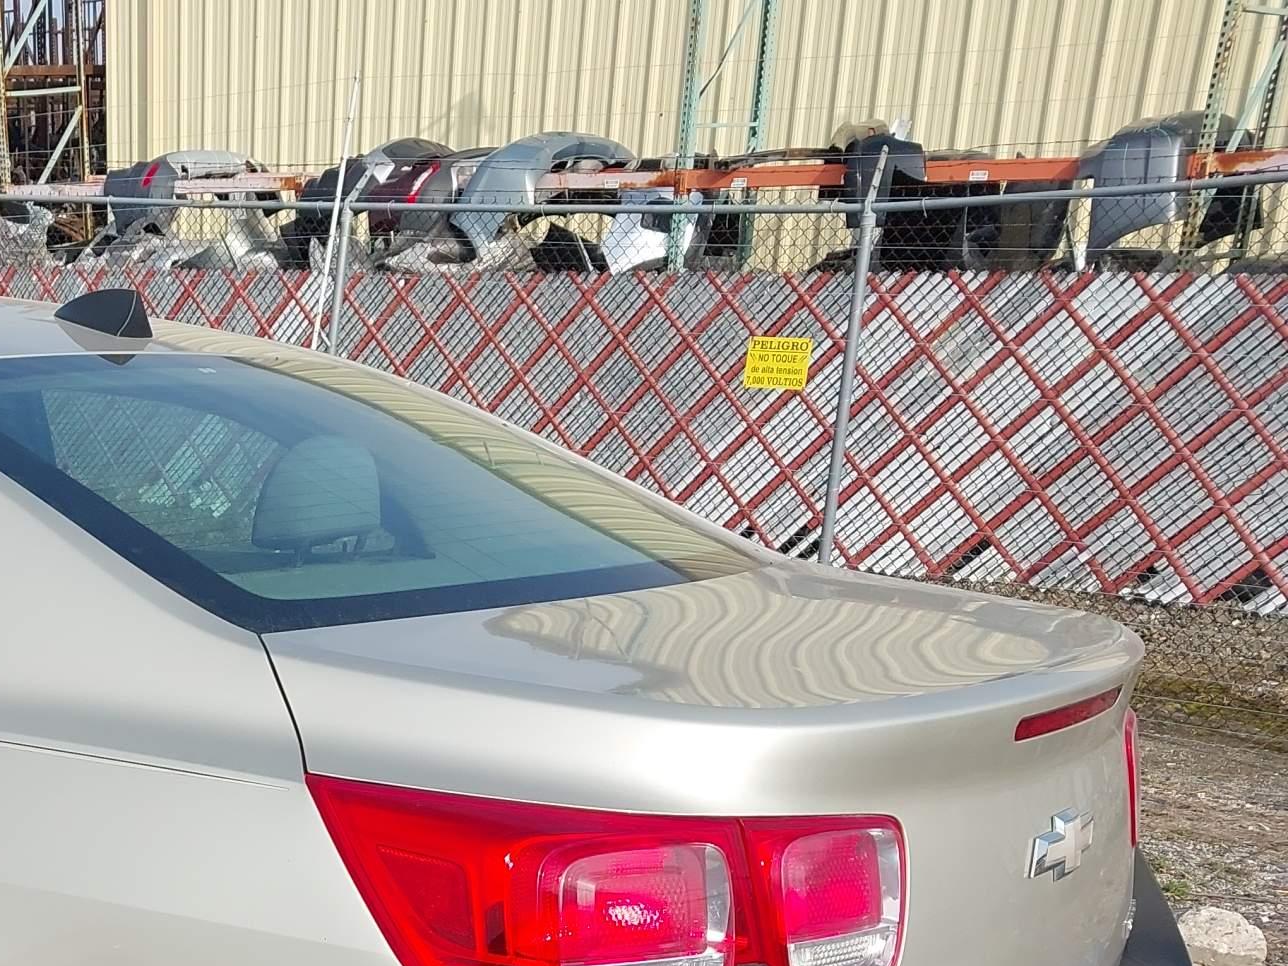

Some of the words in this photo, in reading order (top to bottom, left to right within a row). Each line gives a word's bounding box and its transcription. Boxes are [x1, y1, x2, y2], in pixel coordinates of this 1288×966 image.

[752, 340, 809, 351] PELIGRO
[758, 353, 770, 362] NO
[772, 354, 799, 363] TOQUE
[750, 365, 760, 373] de
[761, 365, 774, 374] alta
[746, 376, 765, 386] 7,000
[766, 376, 804, 387] VOLTIOS
